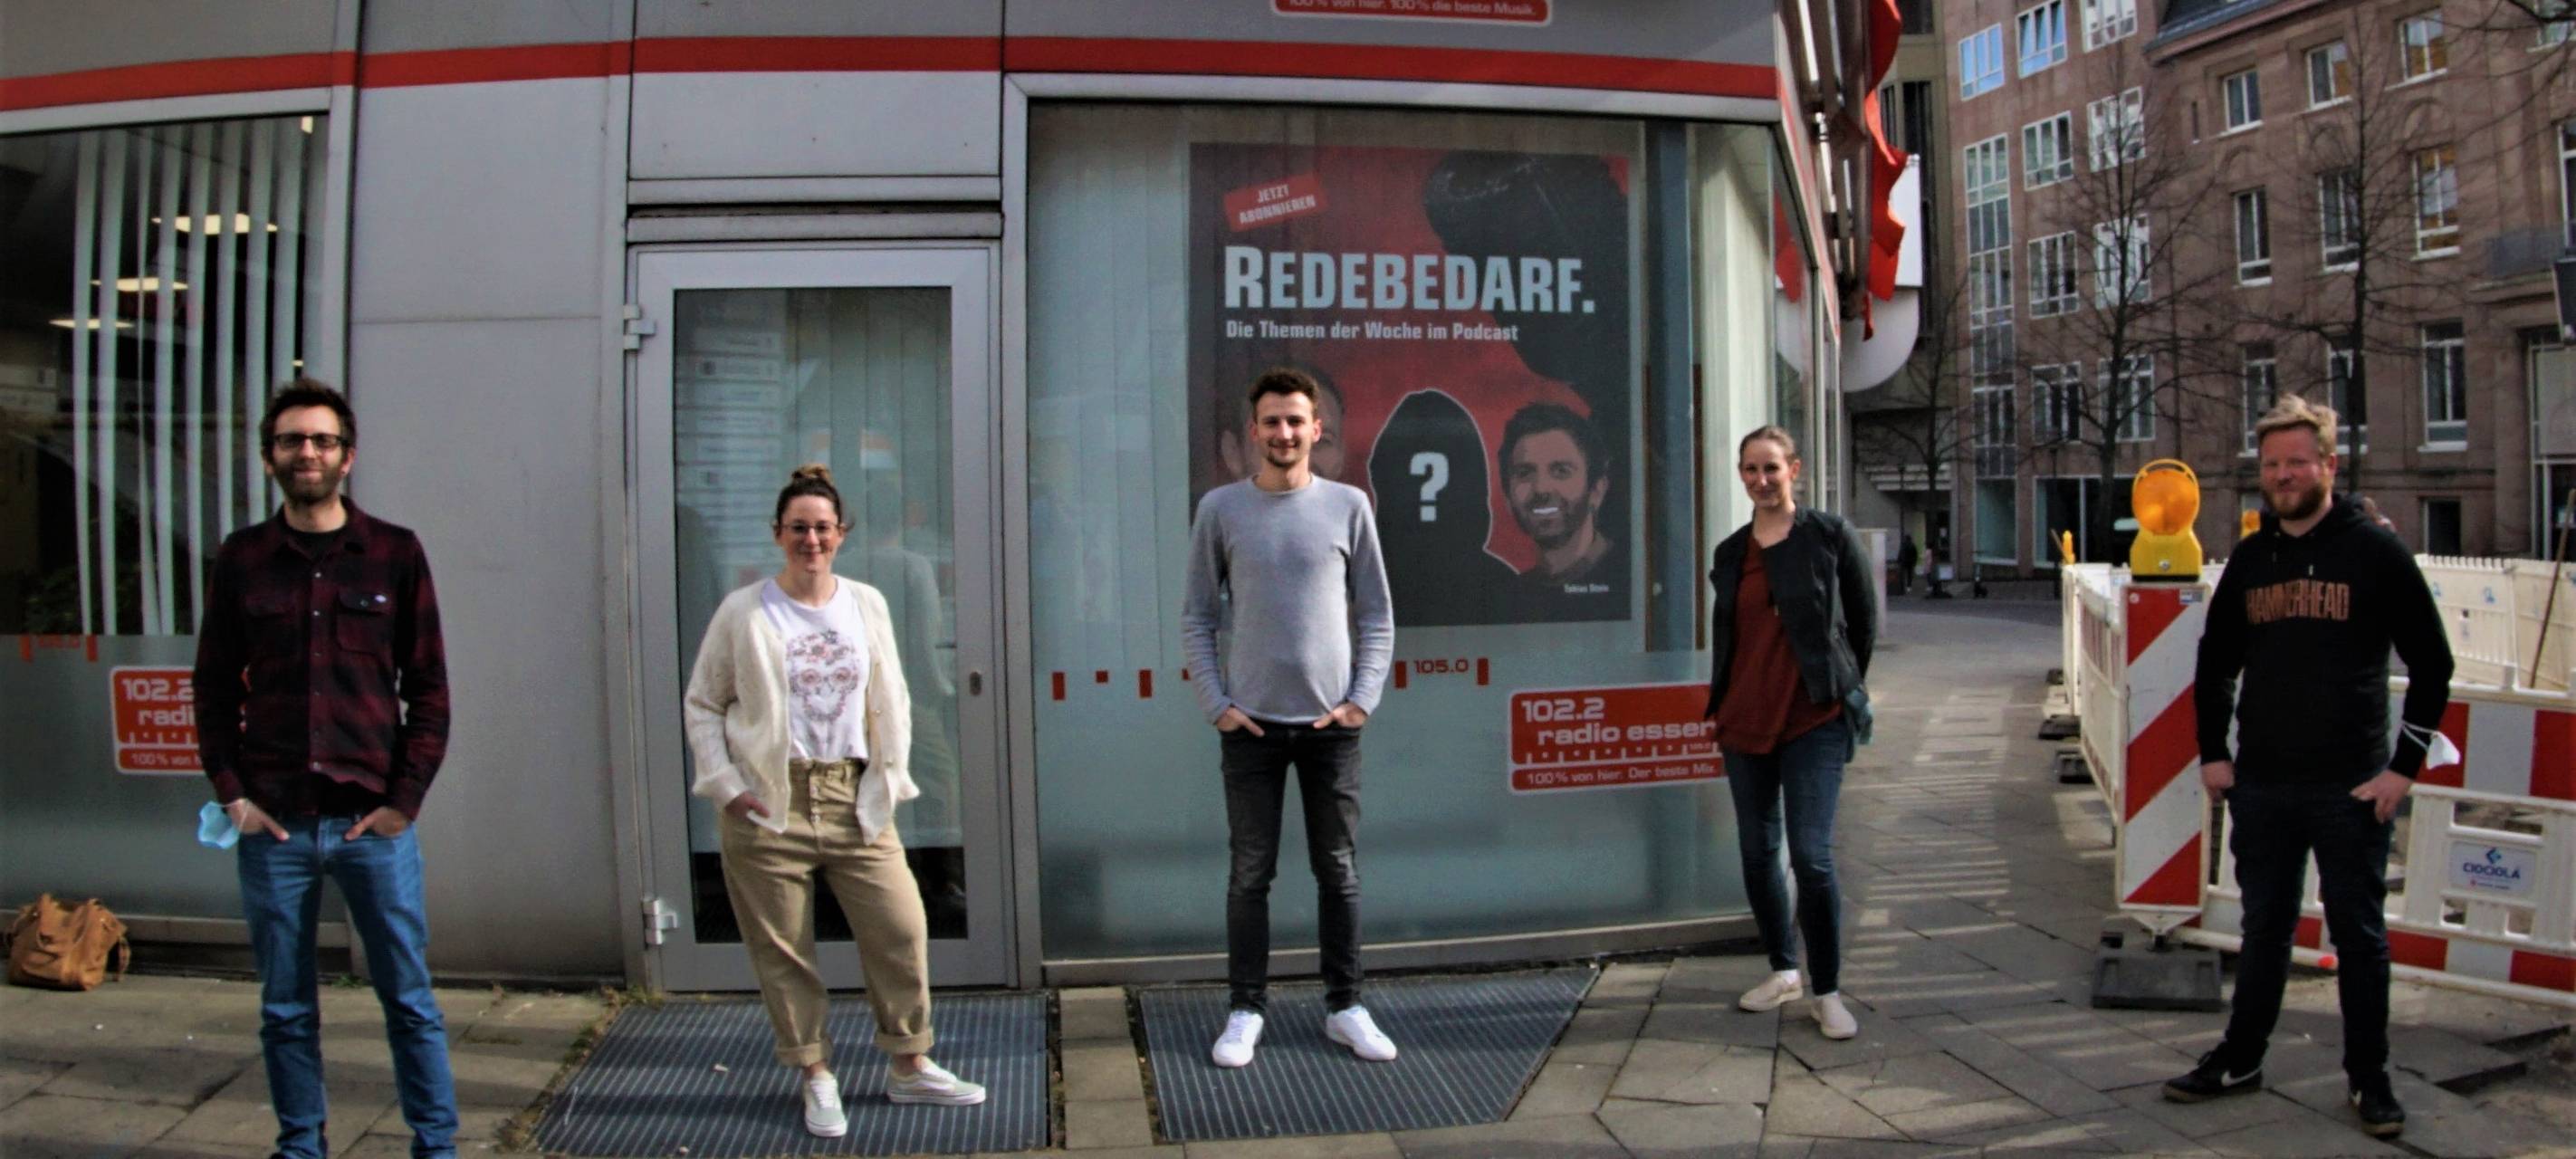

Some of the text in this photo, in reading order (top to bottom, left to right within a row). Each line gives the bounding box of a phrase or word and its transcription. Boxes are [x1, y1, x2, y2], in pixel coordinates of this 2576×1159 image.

[1432, 0, 1451, 11] die
[1454, 1, 1491, 13] beste
[1257, 184, 1289, 204] JETZT
[1239, 194, 1316, 224] ABONNIEREN
[1225, 245, 1595, 313] REDEBEDARF.
[1226, 321, 1518, 340] Die Themen der Woche im Podcast
[1410, 452, 1449, 522] ?
[1413, 658, 1469, 674] 105.0
[121, 677, 195, 702] 102.2
[139, 704, 196, 725] radi
[1521, 697, 1605, 723] 102.2
[1538, 723, 1621, 745] radio
[1527, 771, 1569, 785] 100%
[1571, 772, 1594, 783] von
[1629, 767, 1653, 780] Der
[1655, 765, 1690, 778] beste
